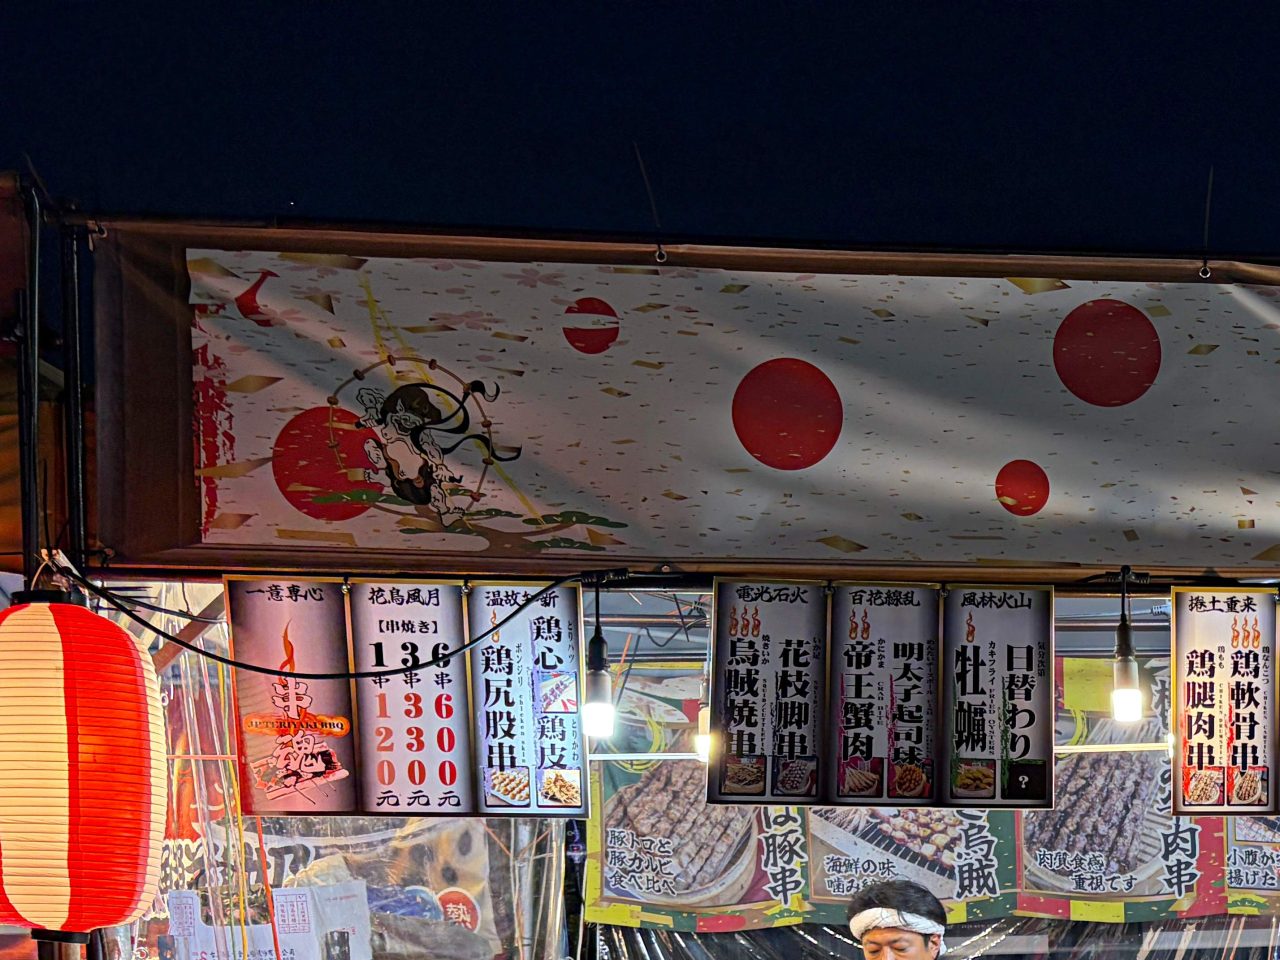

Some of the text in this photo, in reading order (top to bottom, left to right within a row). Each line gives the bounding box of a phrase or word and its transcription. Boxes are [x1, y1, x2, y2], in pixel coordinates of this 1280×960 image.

[368, 588, 440, 607] 花鳥風月
[735, 586, 809, 604] 電光石火
[961, 591, 1031, 610] 風林火山
[988, 641, 996, 686] カキフライ
[843, 641, 875, 762] 帝王蟹肉
[1005, 644, 1037, 760] 日替わり
[1186, 649, 1216, 770] 鶏腿肉串
[1230, 649, 1261, 771] 鶏軟骨串
[608, 829, 672, 855] 豚トロと
[608, 850, 673, 876] 豚カルビ
[825, 856, 898, 876] 海鮮の味
[1037, 850, 1104, 872] 肉質食感
[609, 872, 676, 895] 食べ比べ
